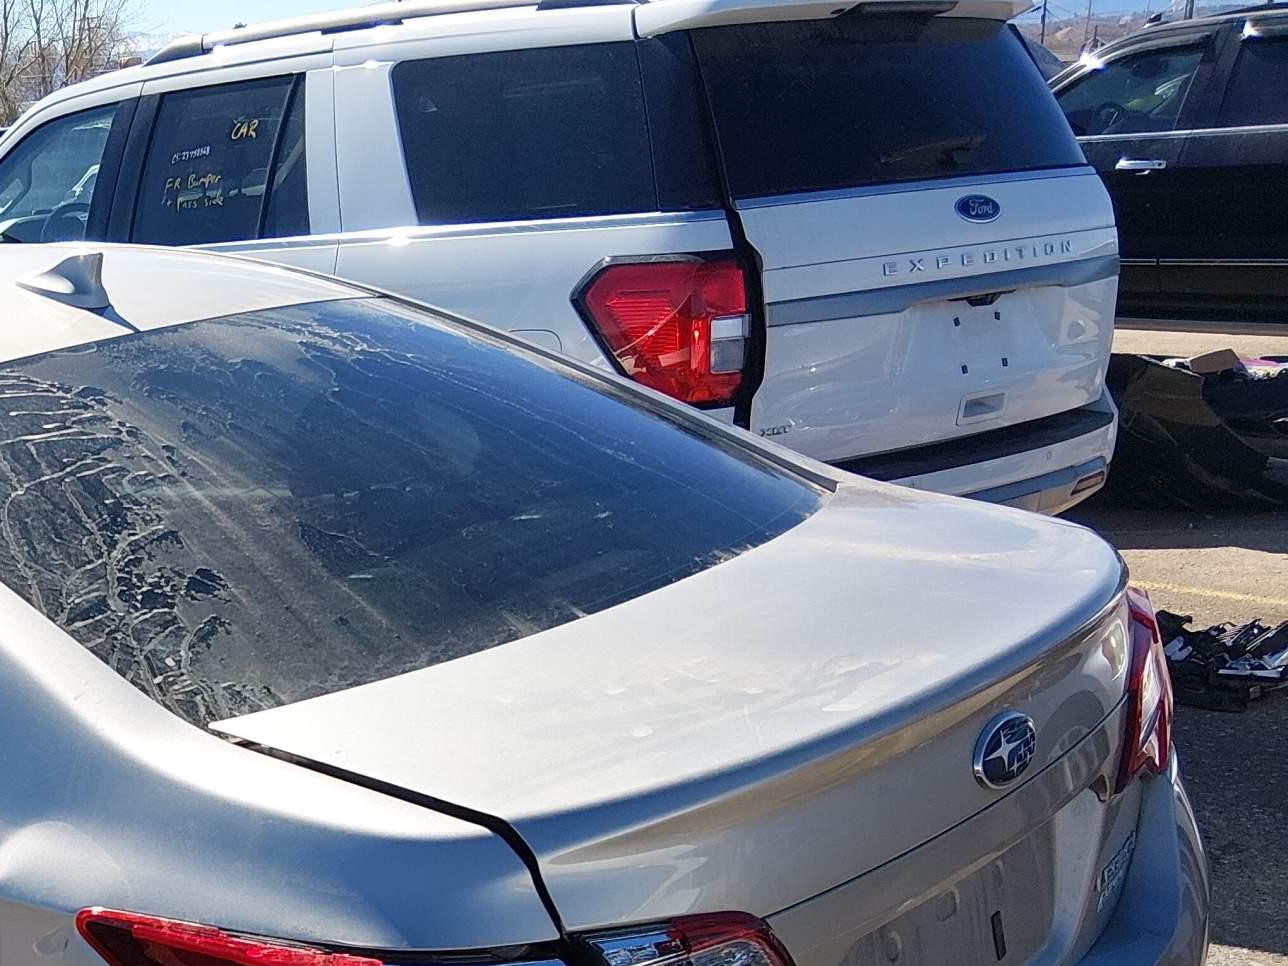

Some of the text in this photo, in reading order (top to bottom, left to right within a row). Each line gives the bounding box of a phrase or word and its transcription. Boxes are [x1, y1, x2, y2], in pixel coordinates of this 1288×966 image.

[231, 119, 259, 140] CAR
[968, 198, 994, 216] Ford
[882, 241, 1072, 277] EXPEDITION
